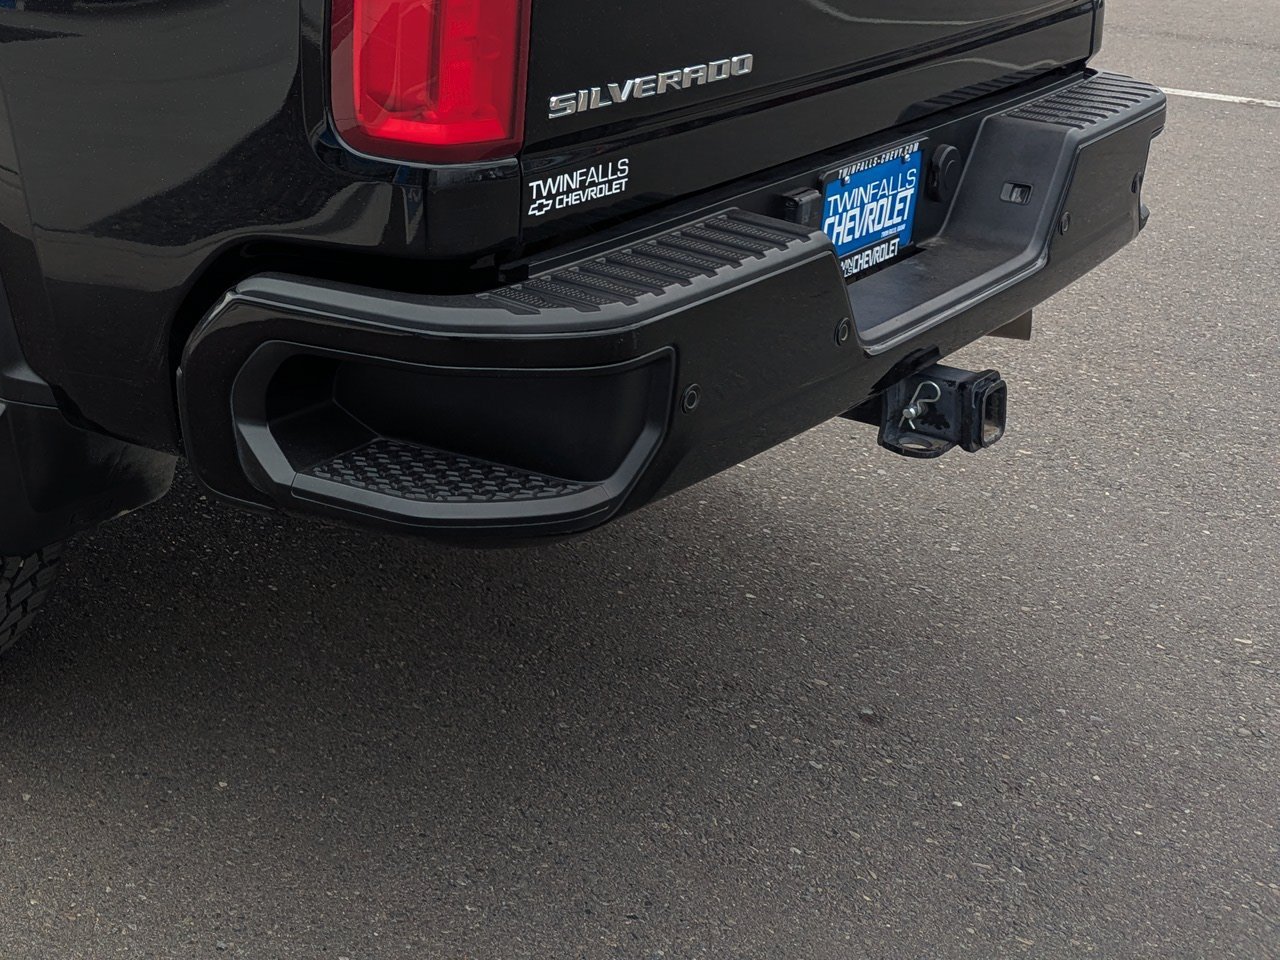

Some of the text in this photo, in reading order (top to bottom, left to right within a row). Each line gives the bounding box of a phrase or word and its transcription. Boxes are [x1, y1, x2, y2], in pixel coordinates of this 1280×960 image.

[548, 53, 754, 120] SILVERADO
[528, 158, 629, 200] TWINFALLS
[555, 178, 628, 209] CHEVROLET
[827, 168, 917, 216] TWINFALLS
[852, 238, 900, 274] CHEVROLET
